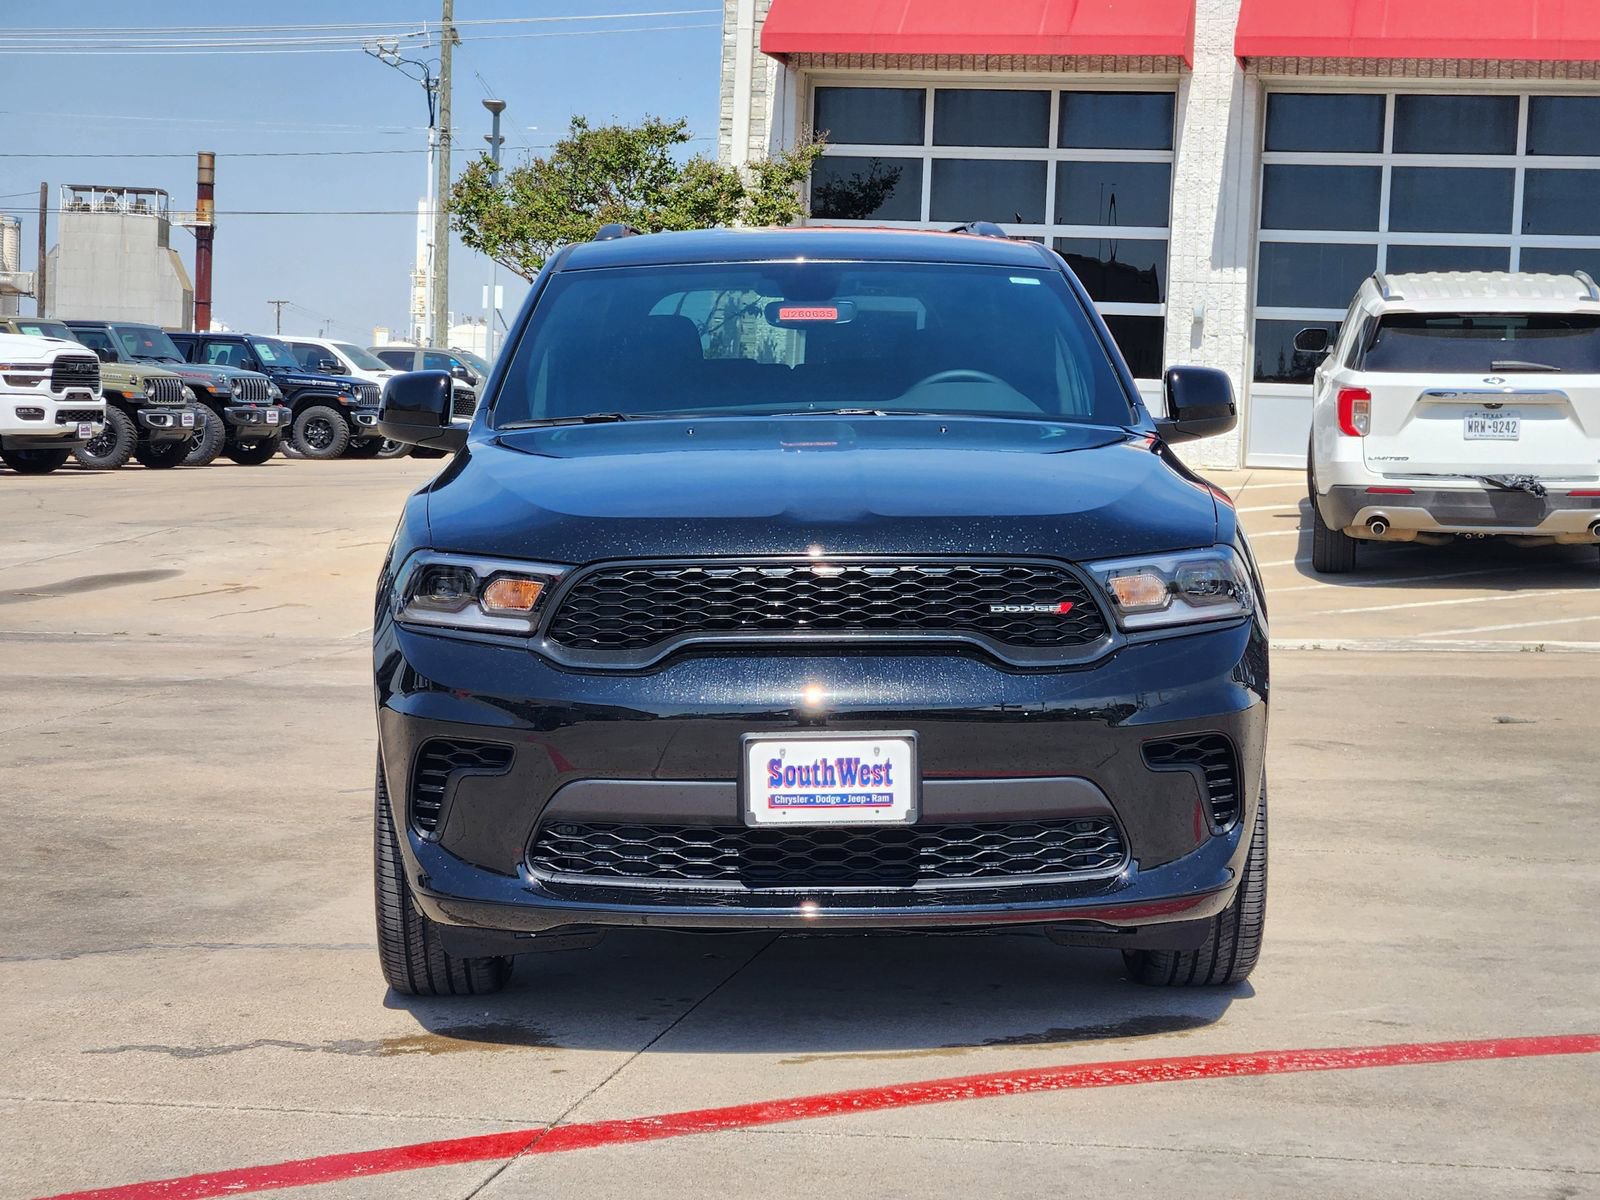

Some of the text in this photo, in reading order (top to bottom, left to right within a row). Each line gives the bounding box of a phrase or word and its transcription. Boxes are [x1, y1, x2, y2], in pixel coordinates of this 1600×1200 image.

[990, 604, 1062, 613] DODGE
[774, 794, 890, 805] Chrysler Dodge Jeep Ram
